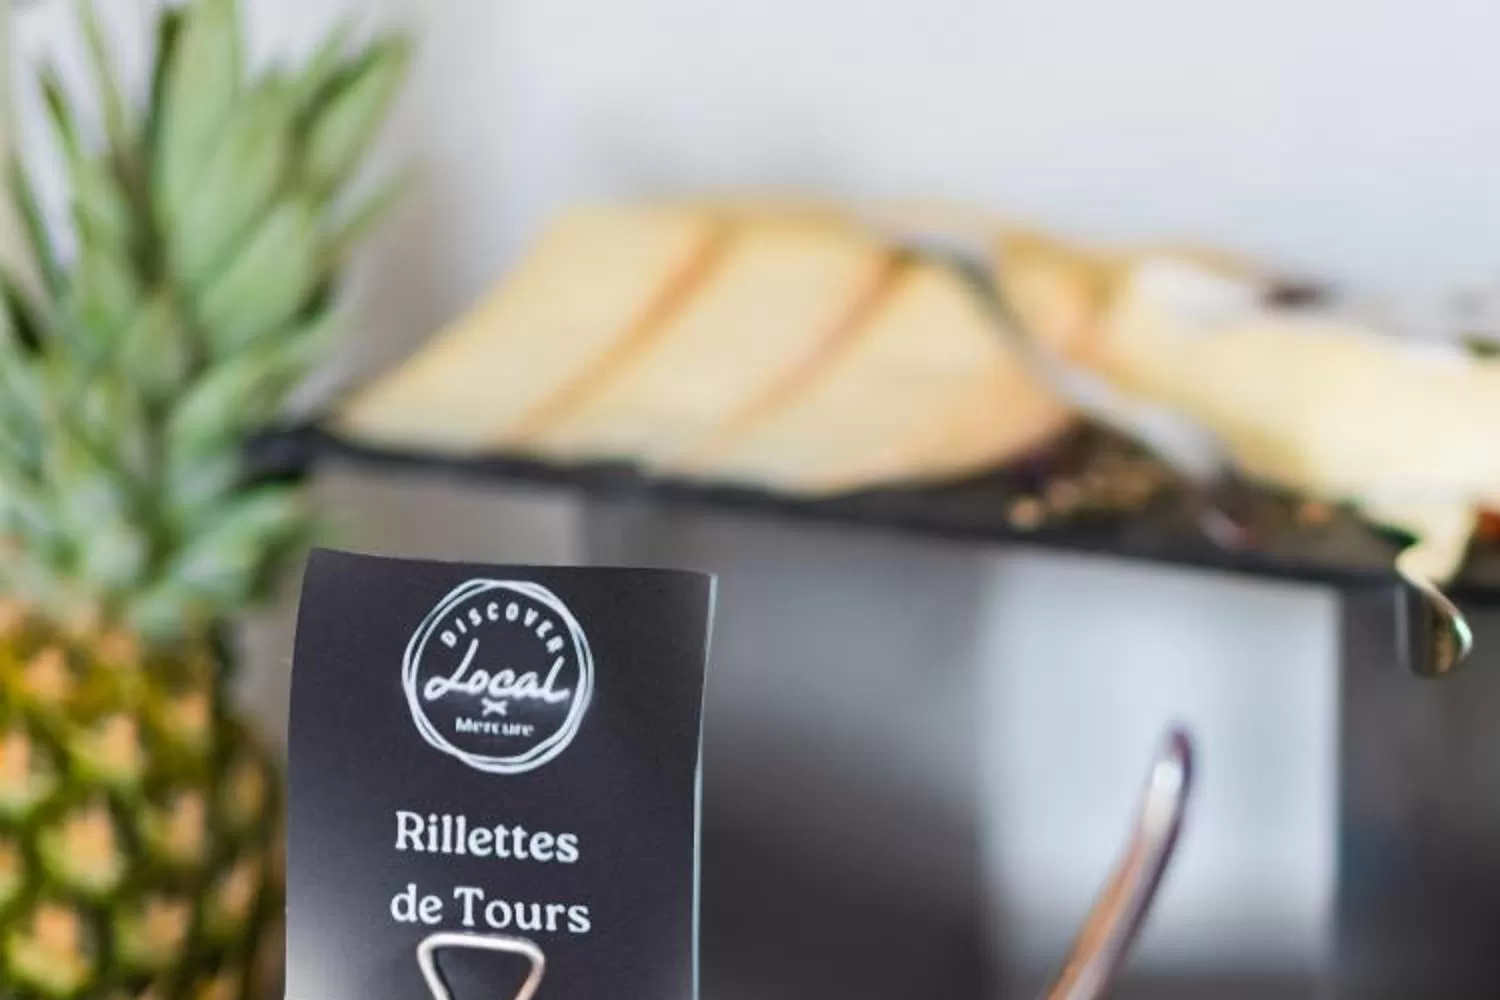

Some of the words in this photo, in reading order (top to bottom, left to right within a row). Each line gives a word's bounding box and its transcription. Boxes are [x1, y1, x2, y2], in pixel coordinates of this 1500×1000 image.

[441, 601, 566, 654] DISCOVER
[424, 637, 571, 702] Local
[455, 716, 535, 737] Mercure
[395, 810, 580, 864] Rillettes
[390, 883, 443, 924] de
[453, 885, 592, 934] Tours
